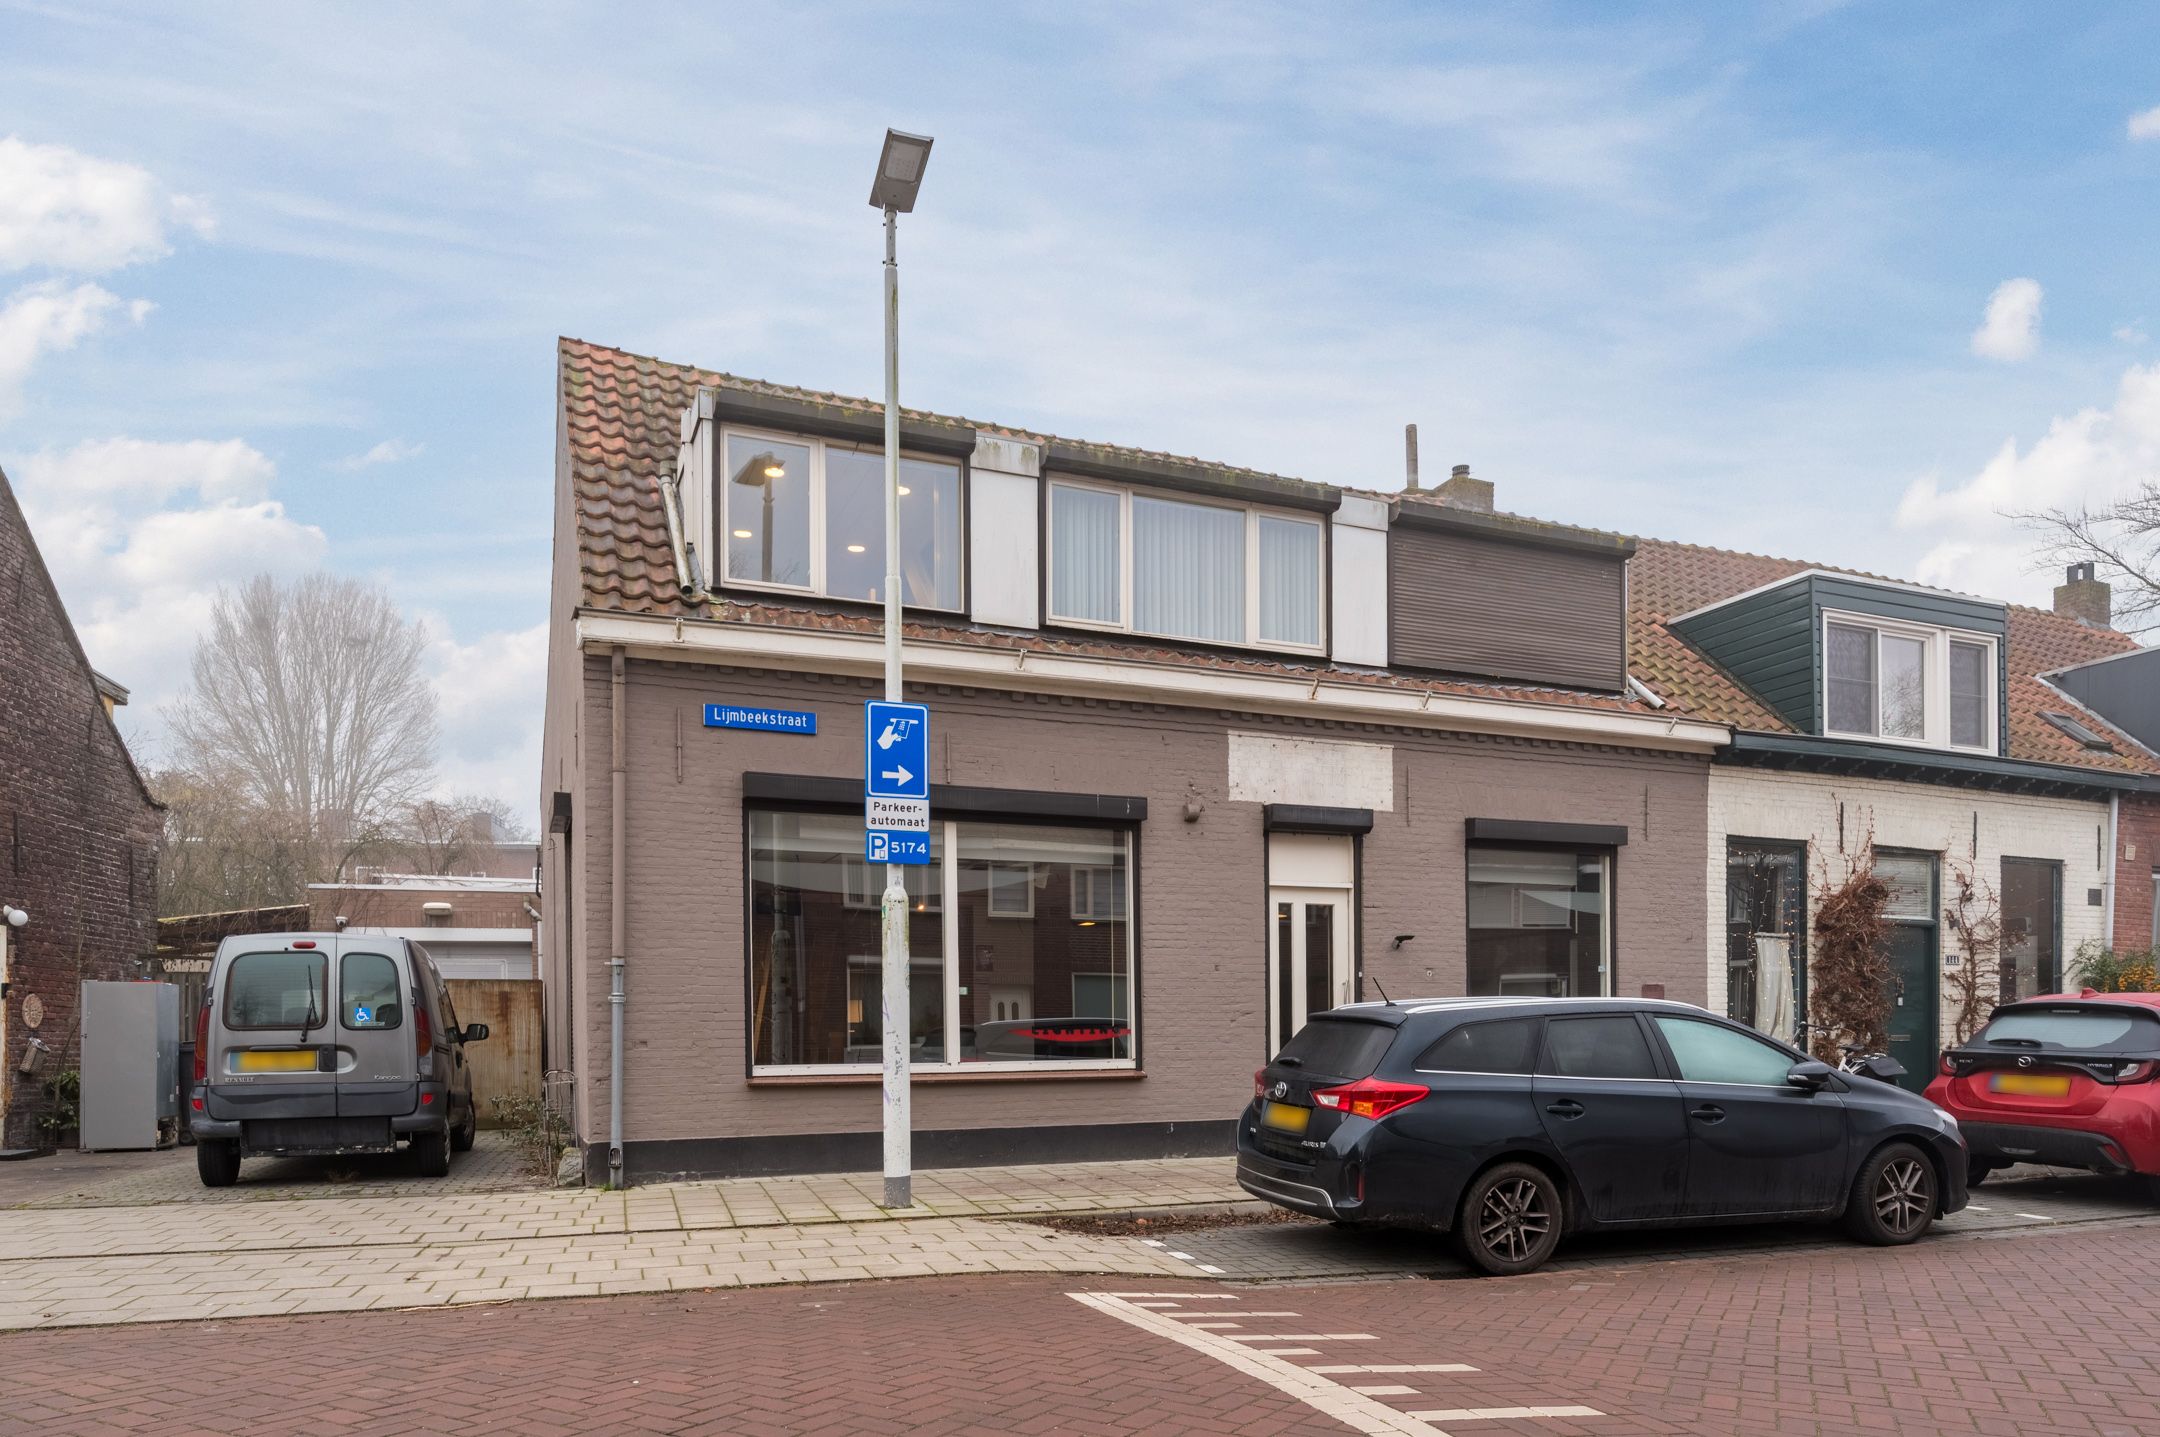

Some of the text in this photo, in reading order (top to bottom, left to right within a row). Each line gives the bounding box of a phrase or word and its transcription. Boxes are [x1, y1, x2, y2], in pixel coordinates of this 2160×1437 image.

[714, 707, 807, 727] Lijmbeekstraat
[873, 801, 923, 813] Parkeer-
[870, 817, 925, 827] automaat
[891, 841, 927, 854] 5174
